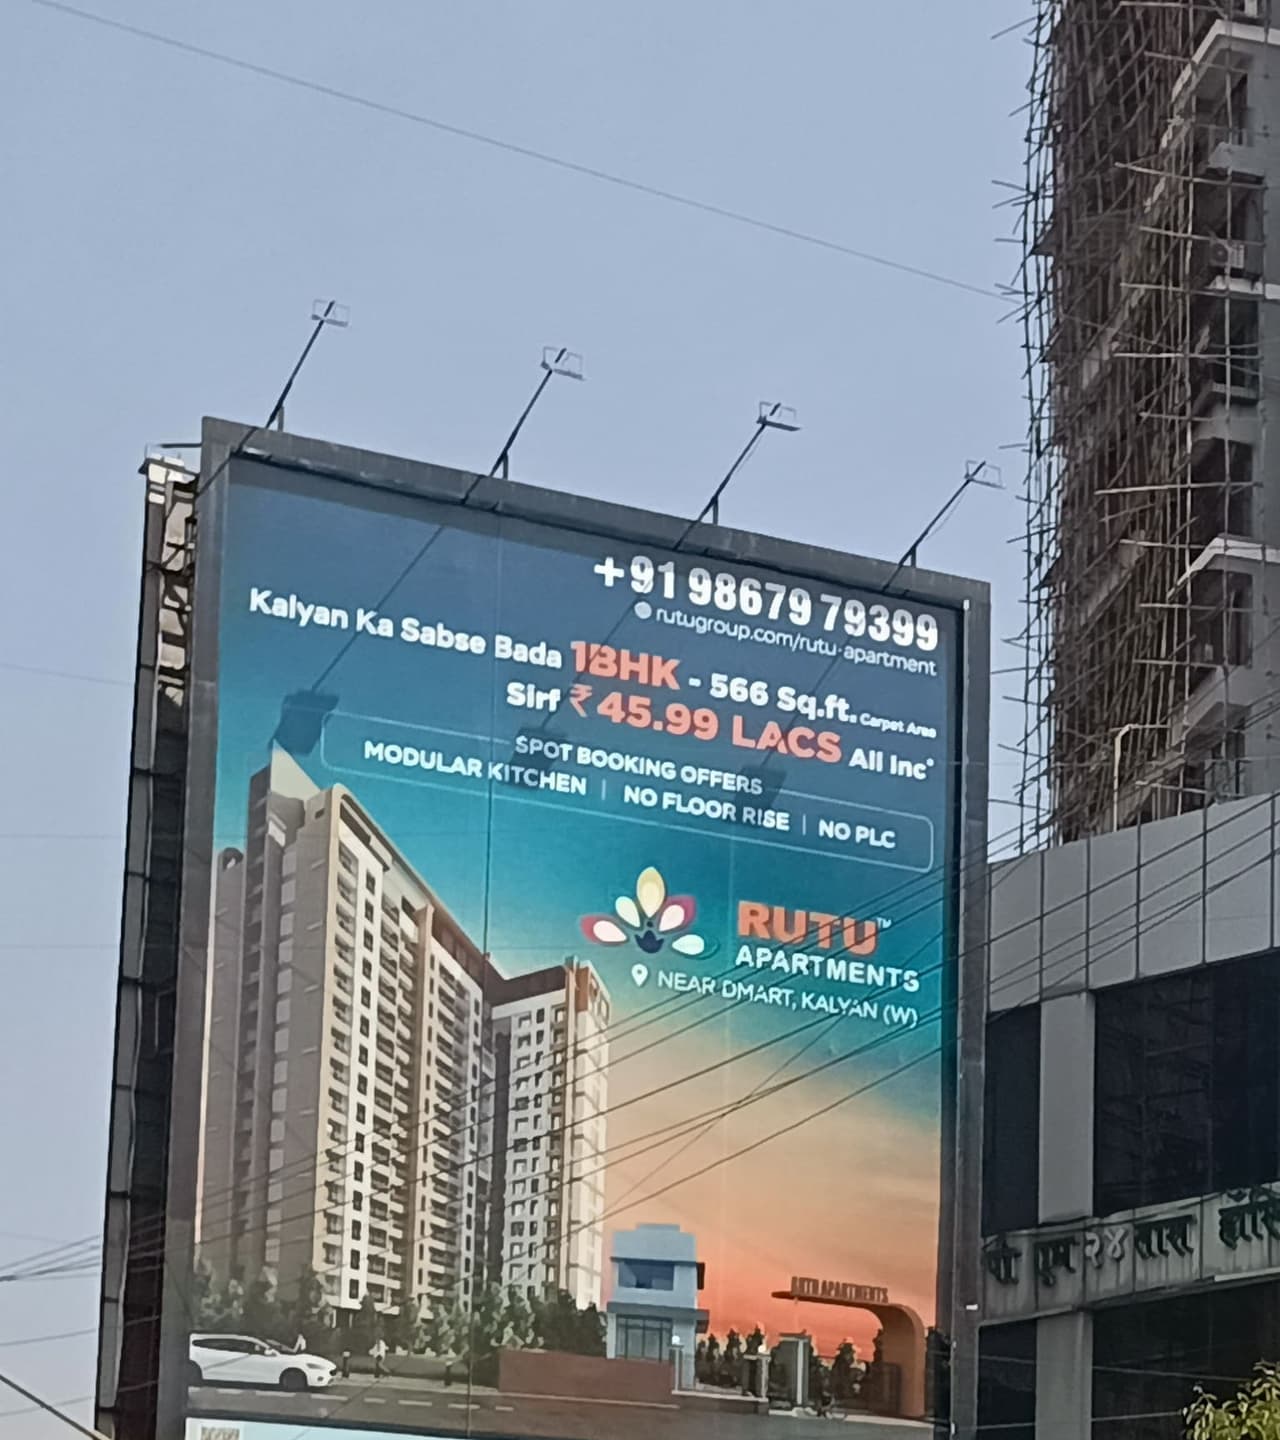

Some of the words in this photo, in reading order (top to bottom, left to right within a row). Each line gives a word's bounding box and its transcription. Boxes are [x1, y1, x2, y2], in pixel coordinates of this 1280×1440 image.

[594, 554, 676, 600] +91
[689, 567, 812, 626] 98679
[820, 593, 939, 651] 79399
[249, 587, 349, 630] Kalyan
[356, 608, 394, 638] Ka
[400, 618, 487, 655] Sabse
[494, 635, 562, 669] Bada
[570, 640, 681, 691] 1BHK
[709, 672, 769, 706] 566
[860, 713, 905, 734] Carpet
[906, 721, 937, 740] Area
[506, 681, 562, 713] Sirf
[731, 714, 843, 764] LACS
[848, 748, 884, 773] All
[515, 735, 573, 762] SPOT
[576, 745, 677, 781] BOOKING
[680, 763, 764, 796] OFFERS
[363, 740, 483, 778] MODULAR
[487, 761, 588, 796] KITCHEN
[623, 784, 659, 808] NO
[662, 791, 737, 823] FLOOR
[742, 807, 791, 832] RISE
[818, 818, 852, 841] NO
[855, 825, 897, 849] PLC
[657, 971, 717, 997] NEAR
[721, 979, 797, 1011] DMART,
[801, 990, 879, 1020] KALYAN
[882, 1002, 919, 1029] (W)
[735, 944, 920, 993] APARTMENTS
